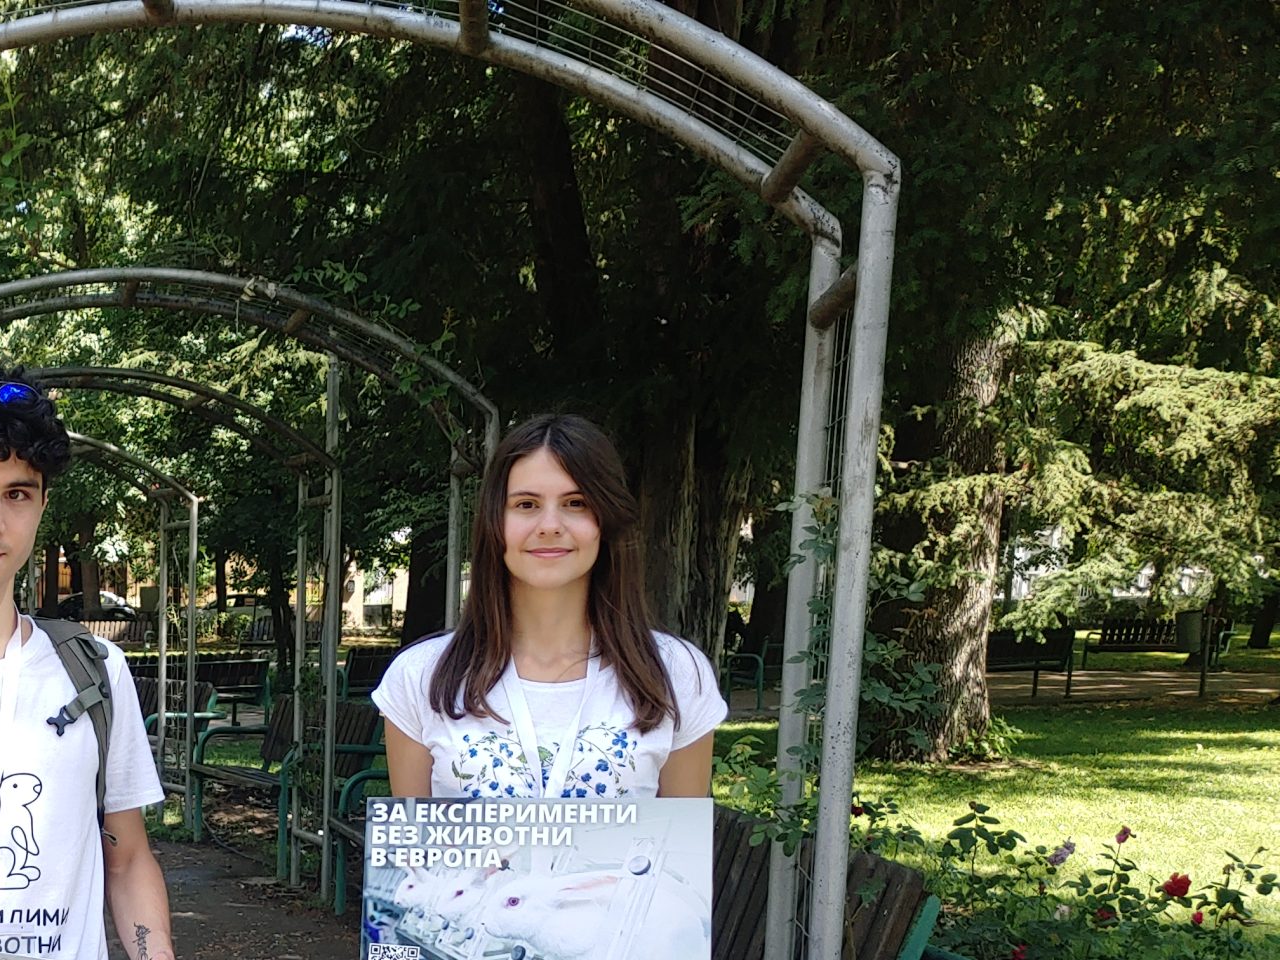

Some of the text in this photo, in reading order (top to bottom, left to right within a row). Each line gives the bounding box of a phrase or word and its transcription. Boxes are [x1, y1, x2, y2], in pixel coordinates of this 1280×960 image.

[372, 803, 637, 823] ЗА ЕКСПЕРИМЕНТИ
[372, 826, 571, 846] БЕЗ ЖИВОТНИ
[371, 848, 502, 867] В ЕВРОПА
